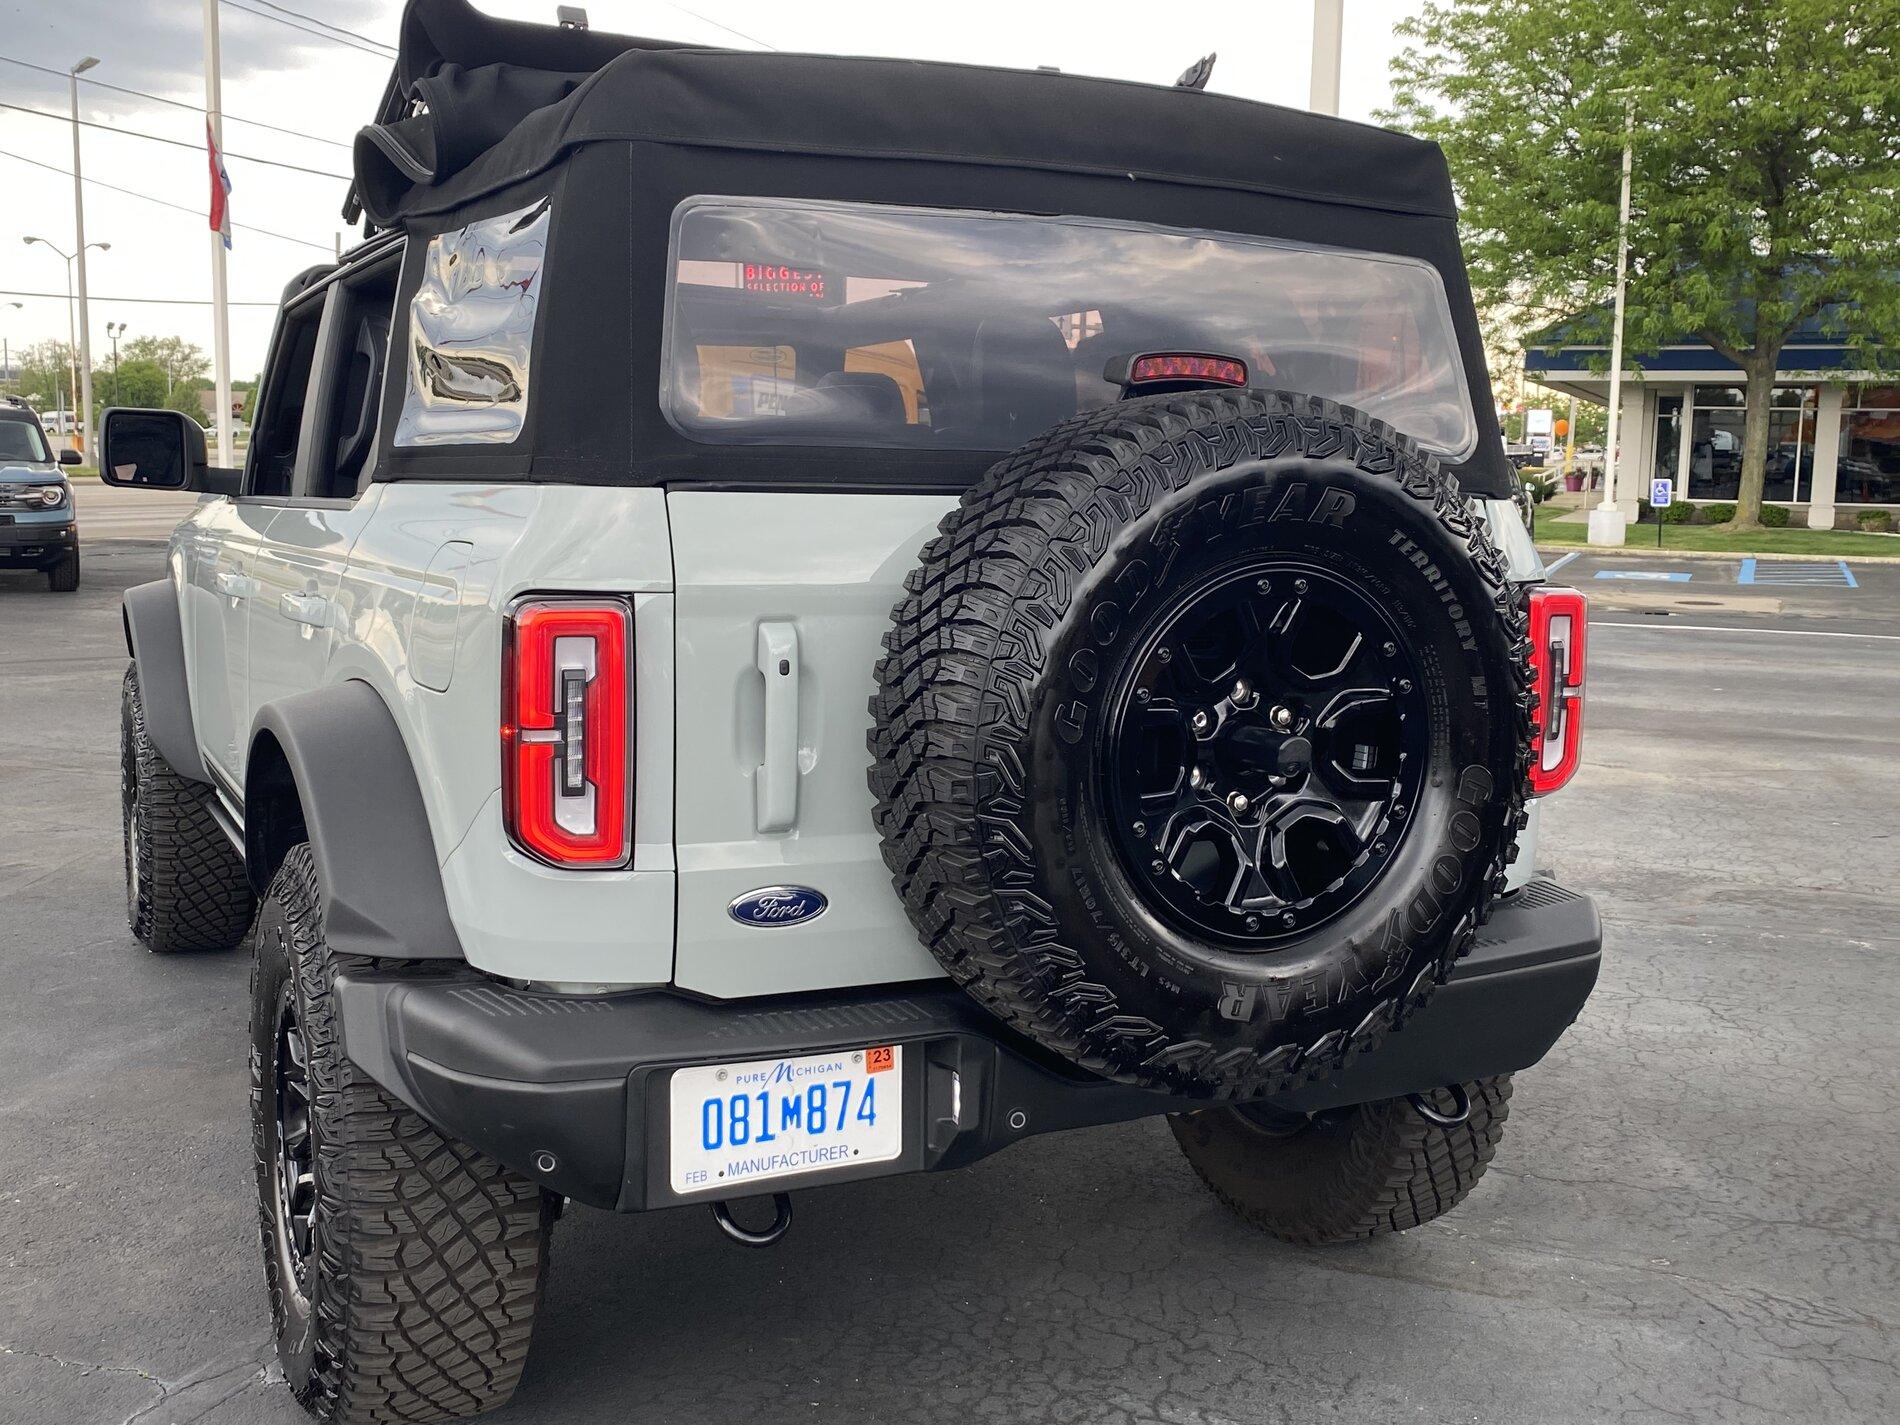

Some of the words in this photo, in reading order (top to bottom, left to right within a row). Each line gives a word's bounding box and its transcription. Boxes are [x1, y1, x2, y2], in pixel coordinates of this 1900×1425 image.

[811, 282, 824, 292] OF
[1388, 528, 1479, 651] TERRITORY
[753, 895, 806, 919] Ford
[873, 1048, 891, 1064] 23
[736, 1072, 767, 1085] PURE
[762, 1062, 843, 1089] MICHIGAN
[702, 1077, 876, 1150] 081M874
[685, 1169, 708, 1184] FEB
[727, 1144, 849, 1177] MANUFACTURER
